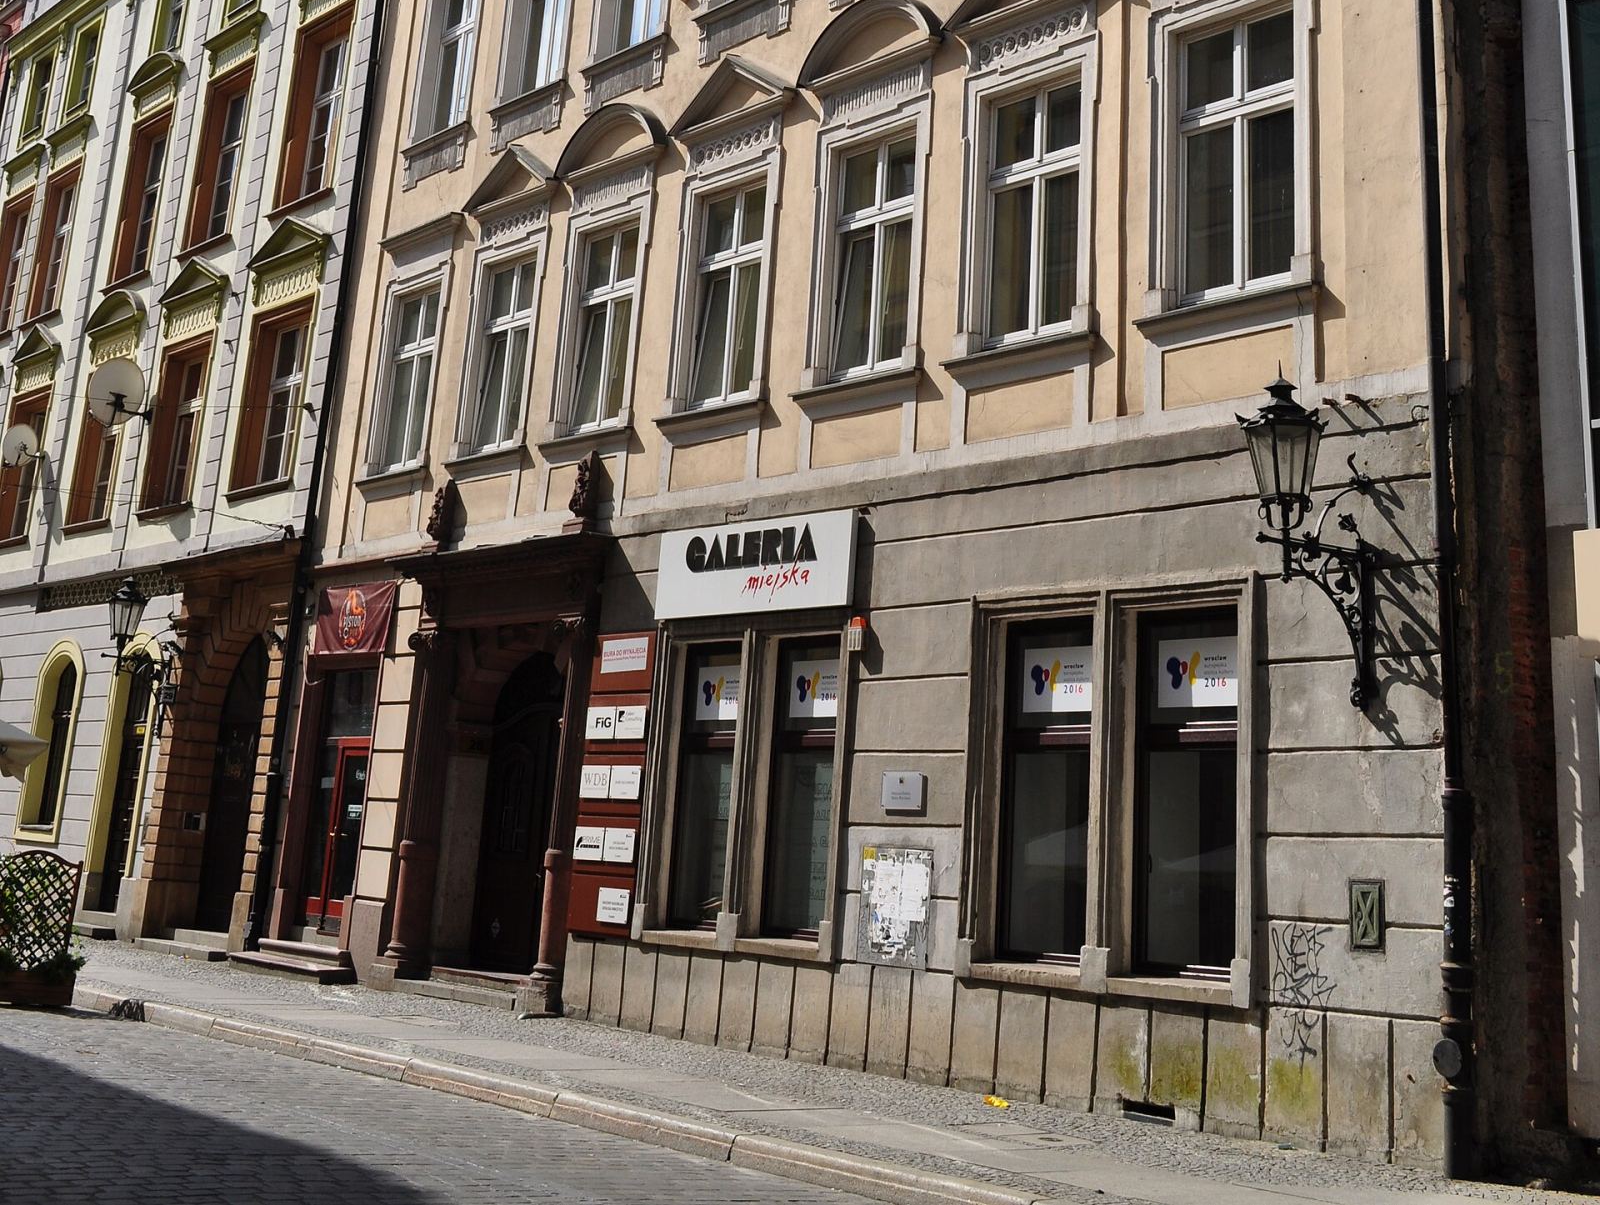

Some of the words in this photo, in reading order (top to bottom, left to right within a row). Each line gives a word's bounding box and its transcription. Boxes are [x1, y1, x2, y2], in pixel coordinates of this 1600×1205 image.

[686, 522, 818, 574] GALERIA
[742, 551, 810, 602] miejska
[1204, 677, 1227, 688] 2016
[1063, 684, 1083, 694] 2016
[821, 692, 836, 701] 2016
[595, 717, 612, 729] FiG
[584, 772, 607, 786] WDB
